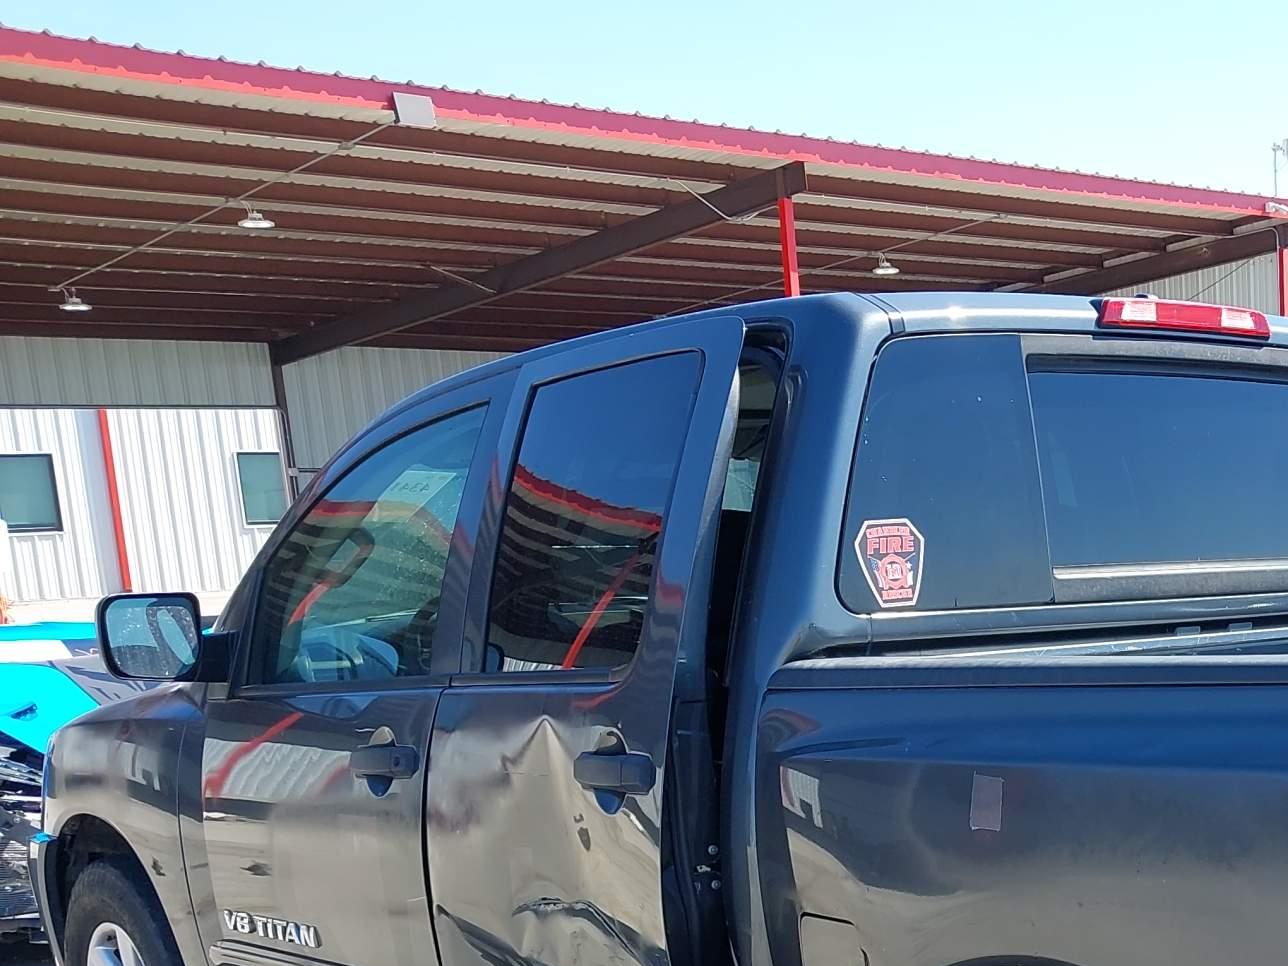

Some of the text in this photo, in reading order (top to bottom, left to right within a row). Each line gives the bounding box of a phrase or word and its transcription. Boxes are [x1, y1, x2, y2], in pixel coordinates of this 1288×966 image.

[867, 536, 915, 554] FIRE
[223, 910, 320, 949] V8 TITAN
